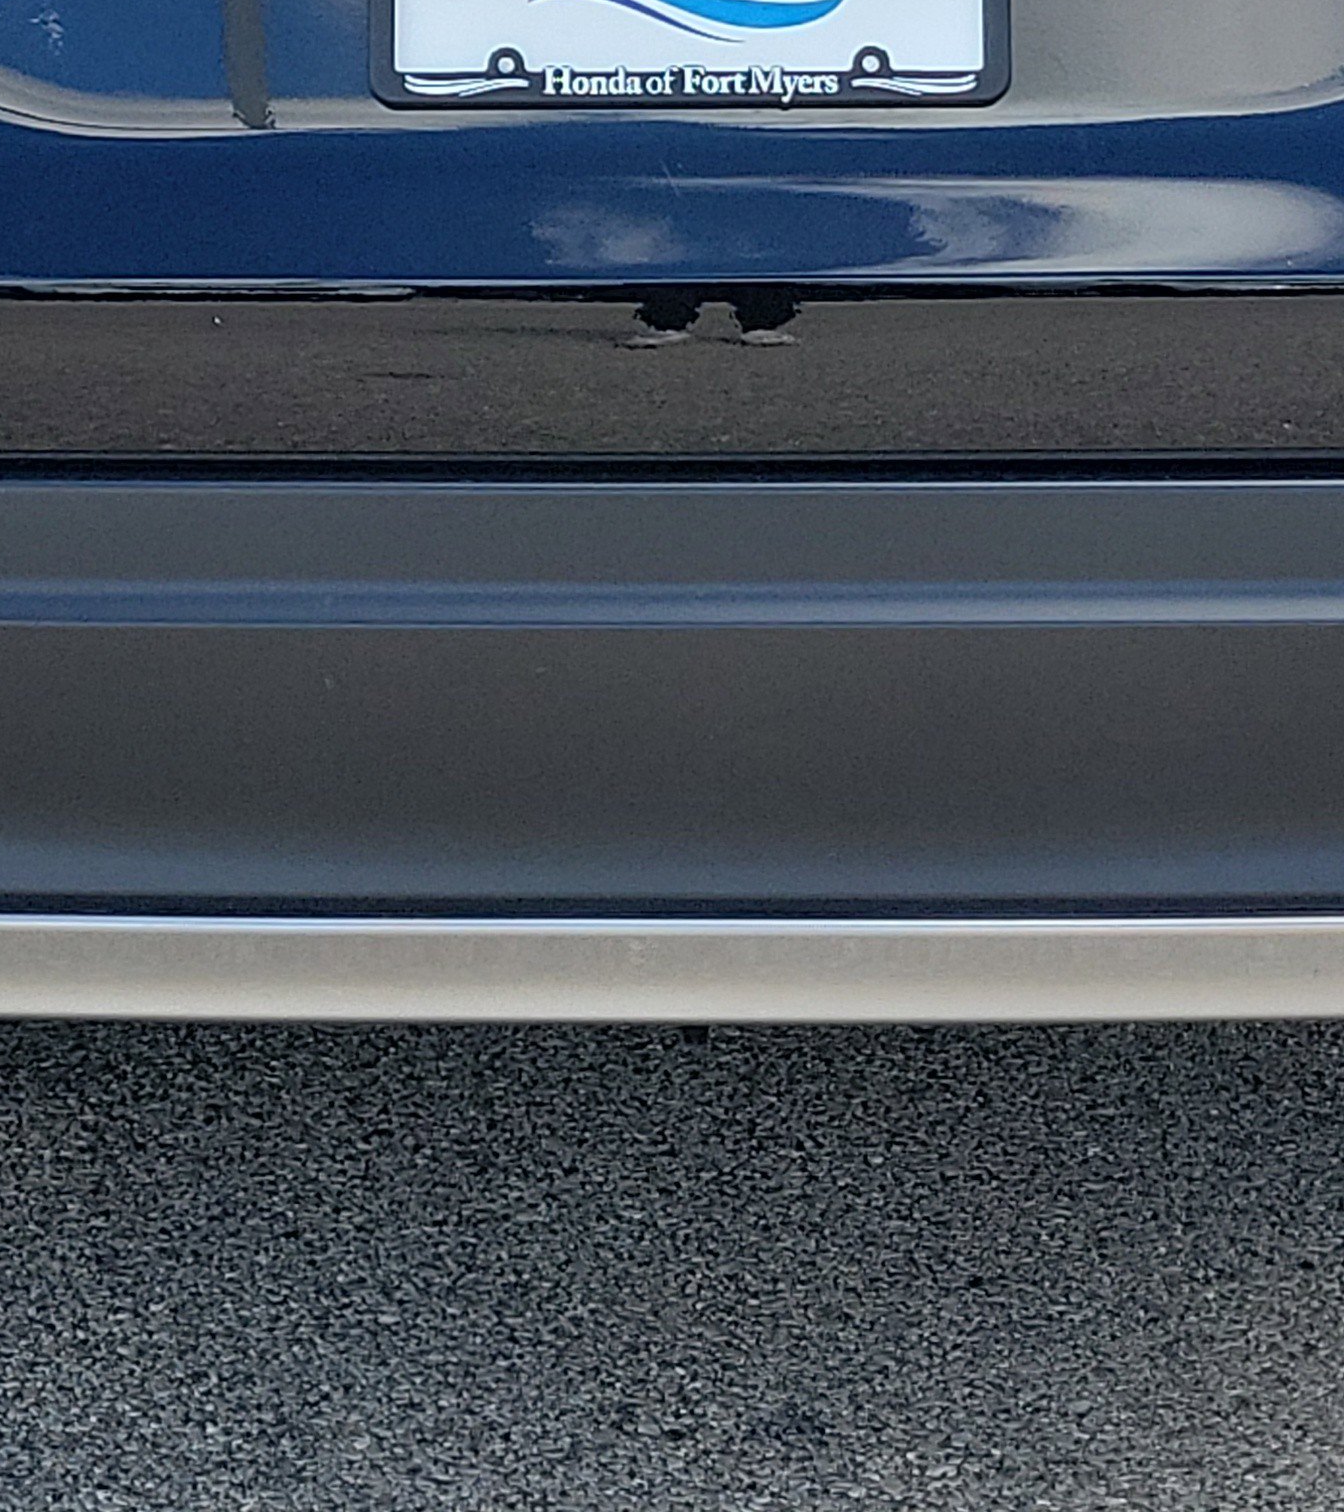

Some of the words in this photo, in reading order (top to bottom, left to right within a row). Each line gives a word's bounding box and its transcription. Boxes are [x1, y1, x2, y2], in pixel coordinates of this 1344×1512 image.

[543, 65, 642, 95] Honda
[645, 65, 679, 95] of
[682, 65, 748, 95] Fort
[748, 65, 839, 103] Myers
